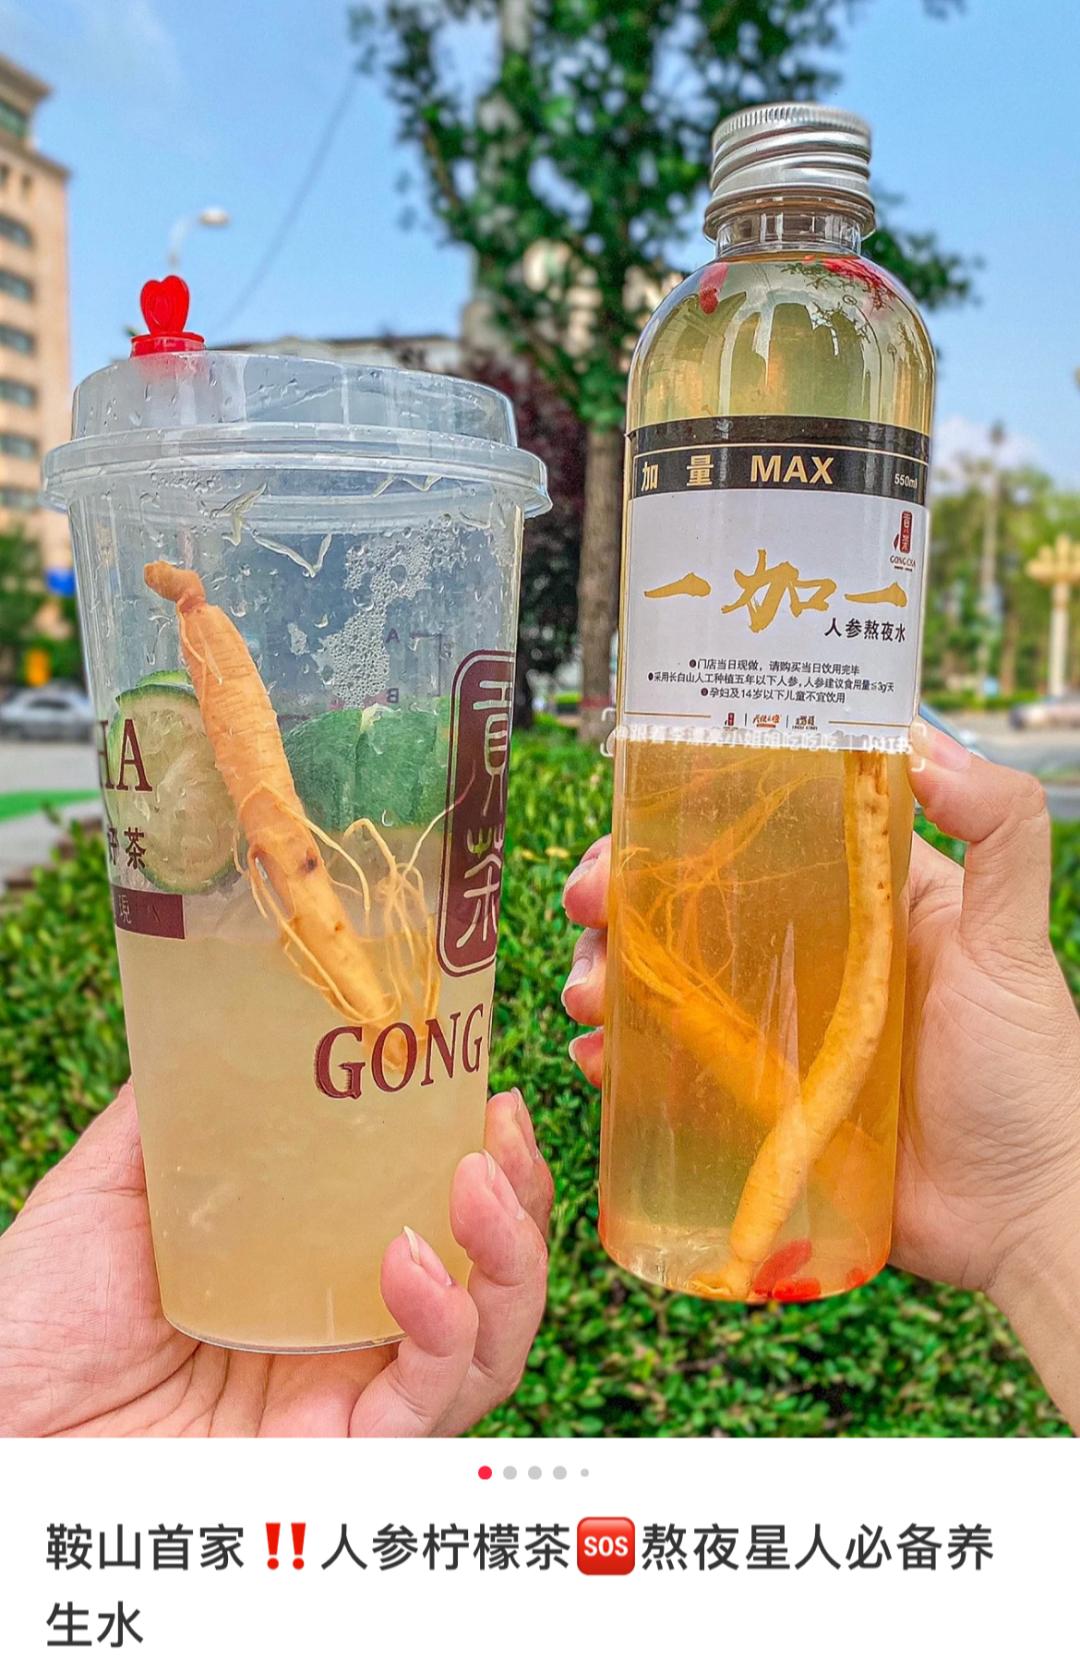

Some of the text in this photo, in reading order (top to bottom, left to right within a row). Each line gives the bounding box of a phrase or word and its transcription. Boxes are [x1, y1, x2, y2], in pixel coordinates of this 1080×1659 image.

[750, 454, 834, 485] MAX
[894, 472, 918, 489] 550ml
[824, 617, 906, 642] 人参熬夜水
[709, 687, 846, 704] 孕妇及14岁以下儿童不宜饮用
[313, 1003, 484, 1100] GONG
